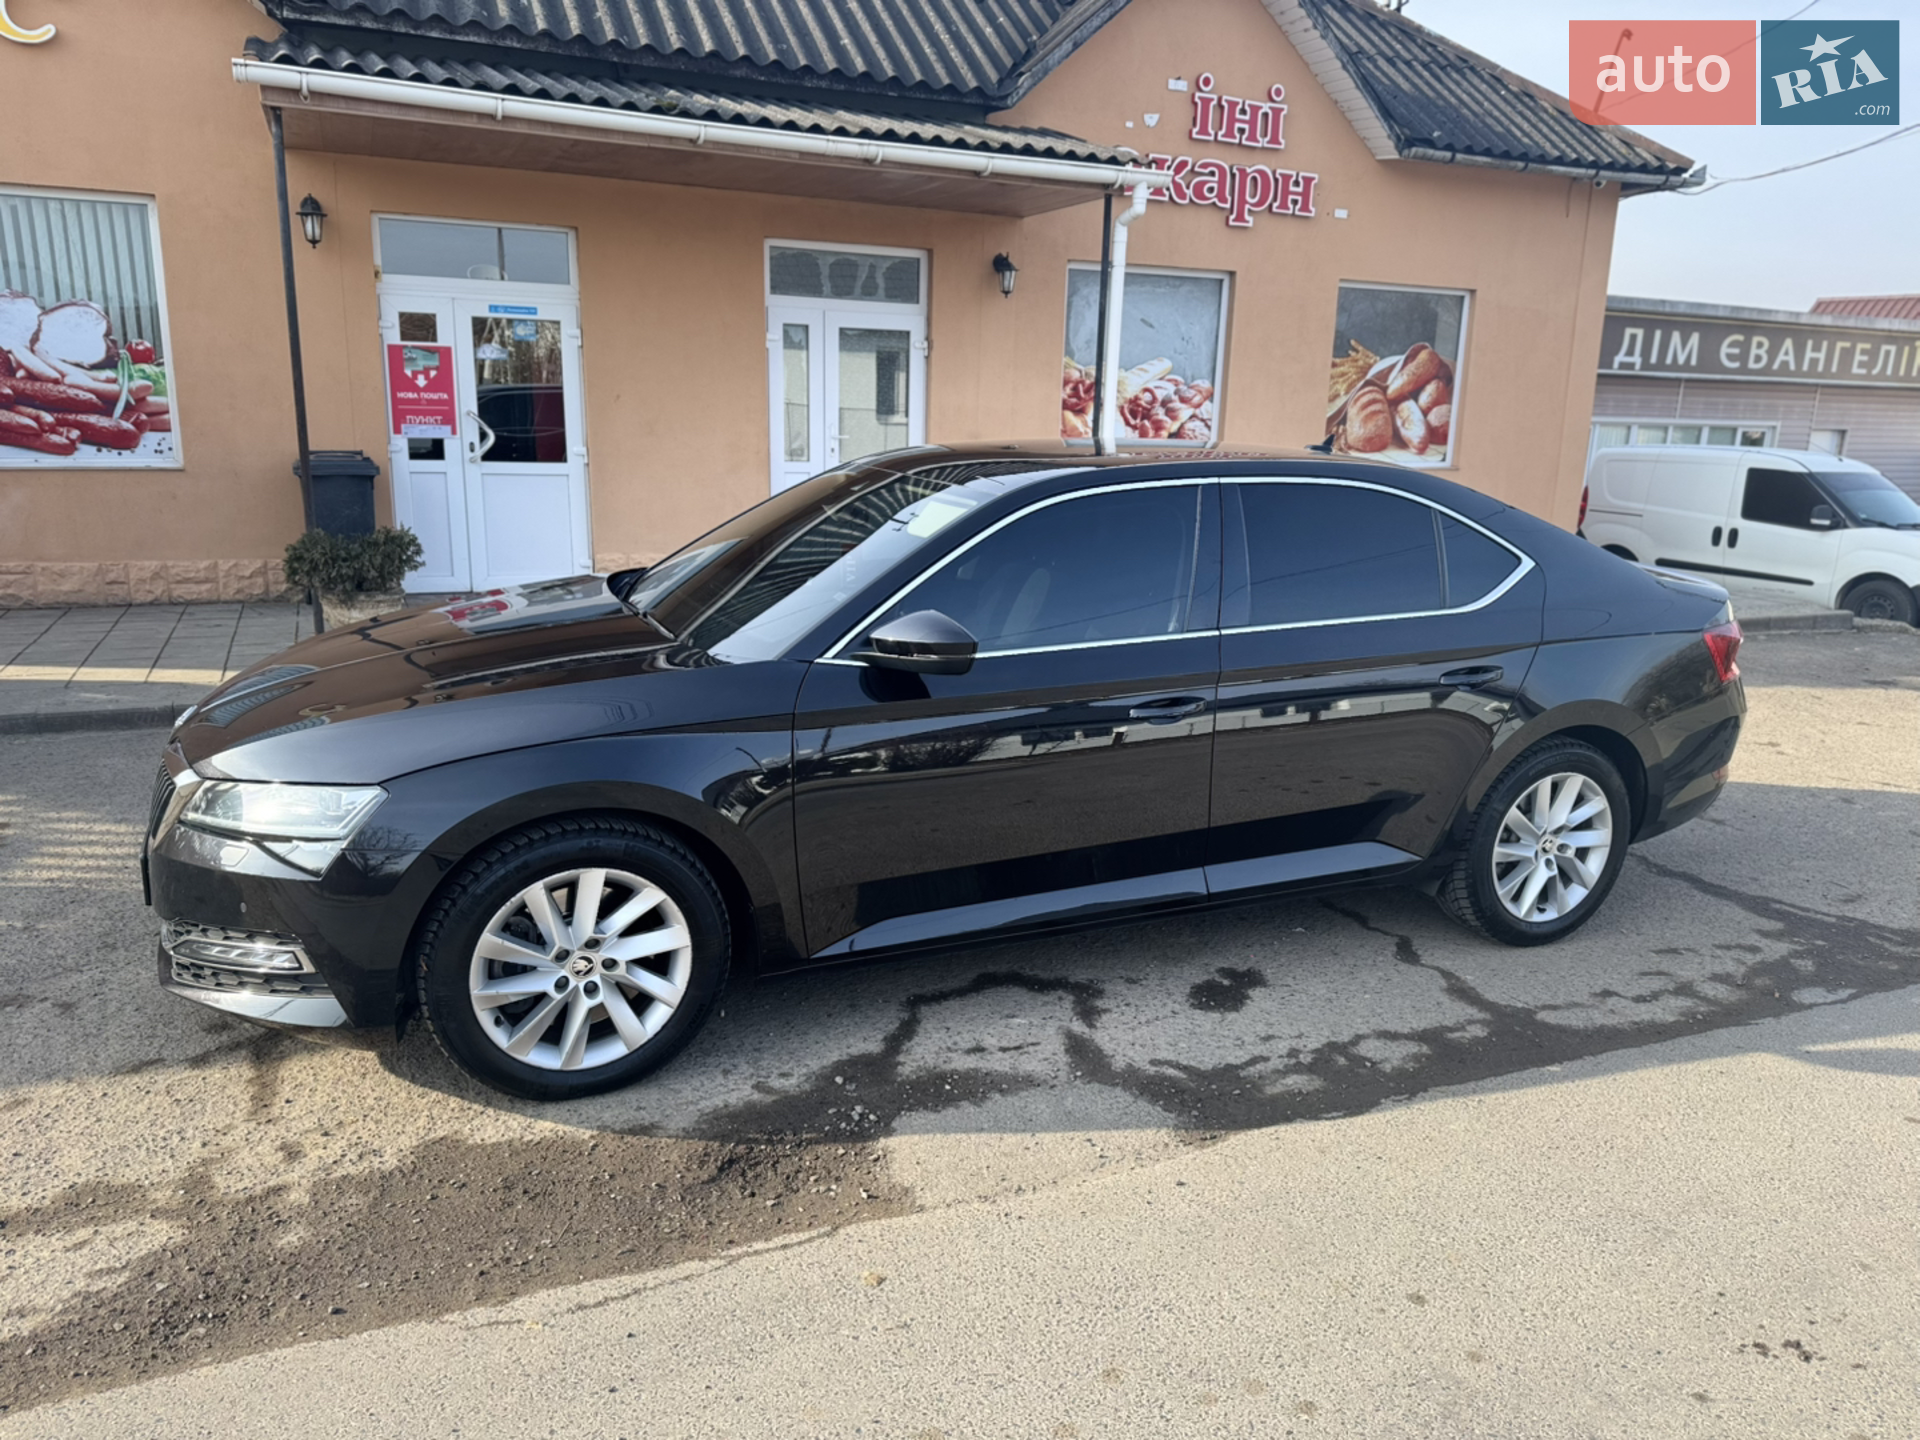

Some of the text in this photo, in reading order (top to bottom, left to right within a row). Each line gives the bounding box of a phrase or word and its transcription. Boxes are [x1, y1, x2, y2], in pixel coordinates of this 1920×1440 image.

[1612, 327, 1700, 371] ДІМ
[397, 391, 449, 400] НОВА ПОШТА
[405, 415, 443, 425] ПУНКТ
